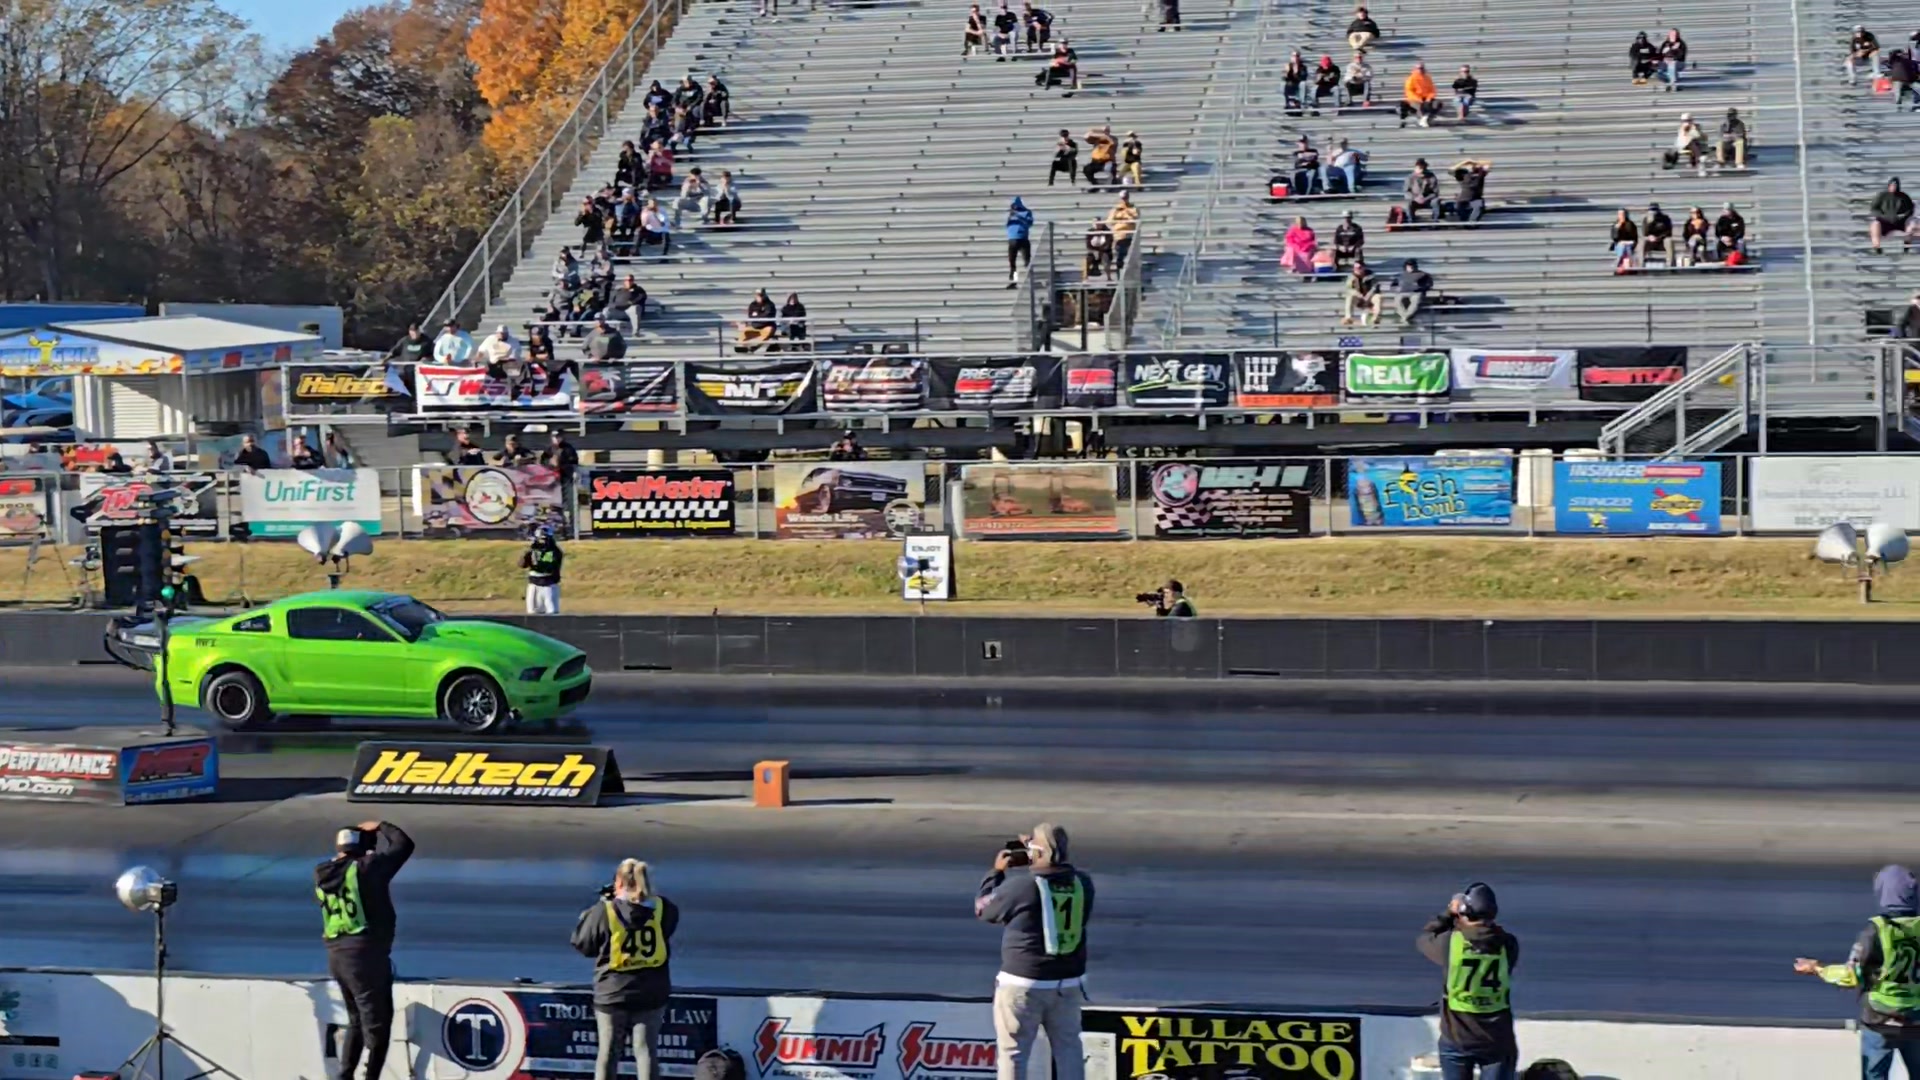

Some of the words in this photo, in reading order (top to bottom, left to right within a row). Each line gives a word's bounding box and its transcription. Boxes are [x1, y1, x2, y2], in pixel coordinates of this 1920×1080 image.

[1134, 360, 1180, 383] NEXT
[1184, 363, 1222, 381] GEN
[1356, 363, 1418, 385] REAL
[1569, 464, 1646, 477] INSINGER
[265, 480, 356, 502] UniFirst
[592, 475, 727, 500] SealMaster
[1404, 495, 1467, 521] bomb
[1569, 497, 1633, 507] STINGER
[362, 751, 596, 787] Haltech
[354, 784, 407, 795] ENGINE
[411, 785, 512, 797] MANAGEMENT
[513, 787, 581, 797] SYSTEMS
[621, 926, 657, 958] 49
[1461, 958, 1502, 993] 74
[670, 1008, 713, 1025] LAW
[455, 1013, 497, 1060] T
[1121, 1016, 1354, 1043] VILLAGE
[1121, 1038, 1354, 1080] TATTOO
